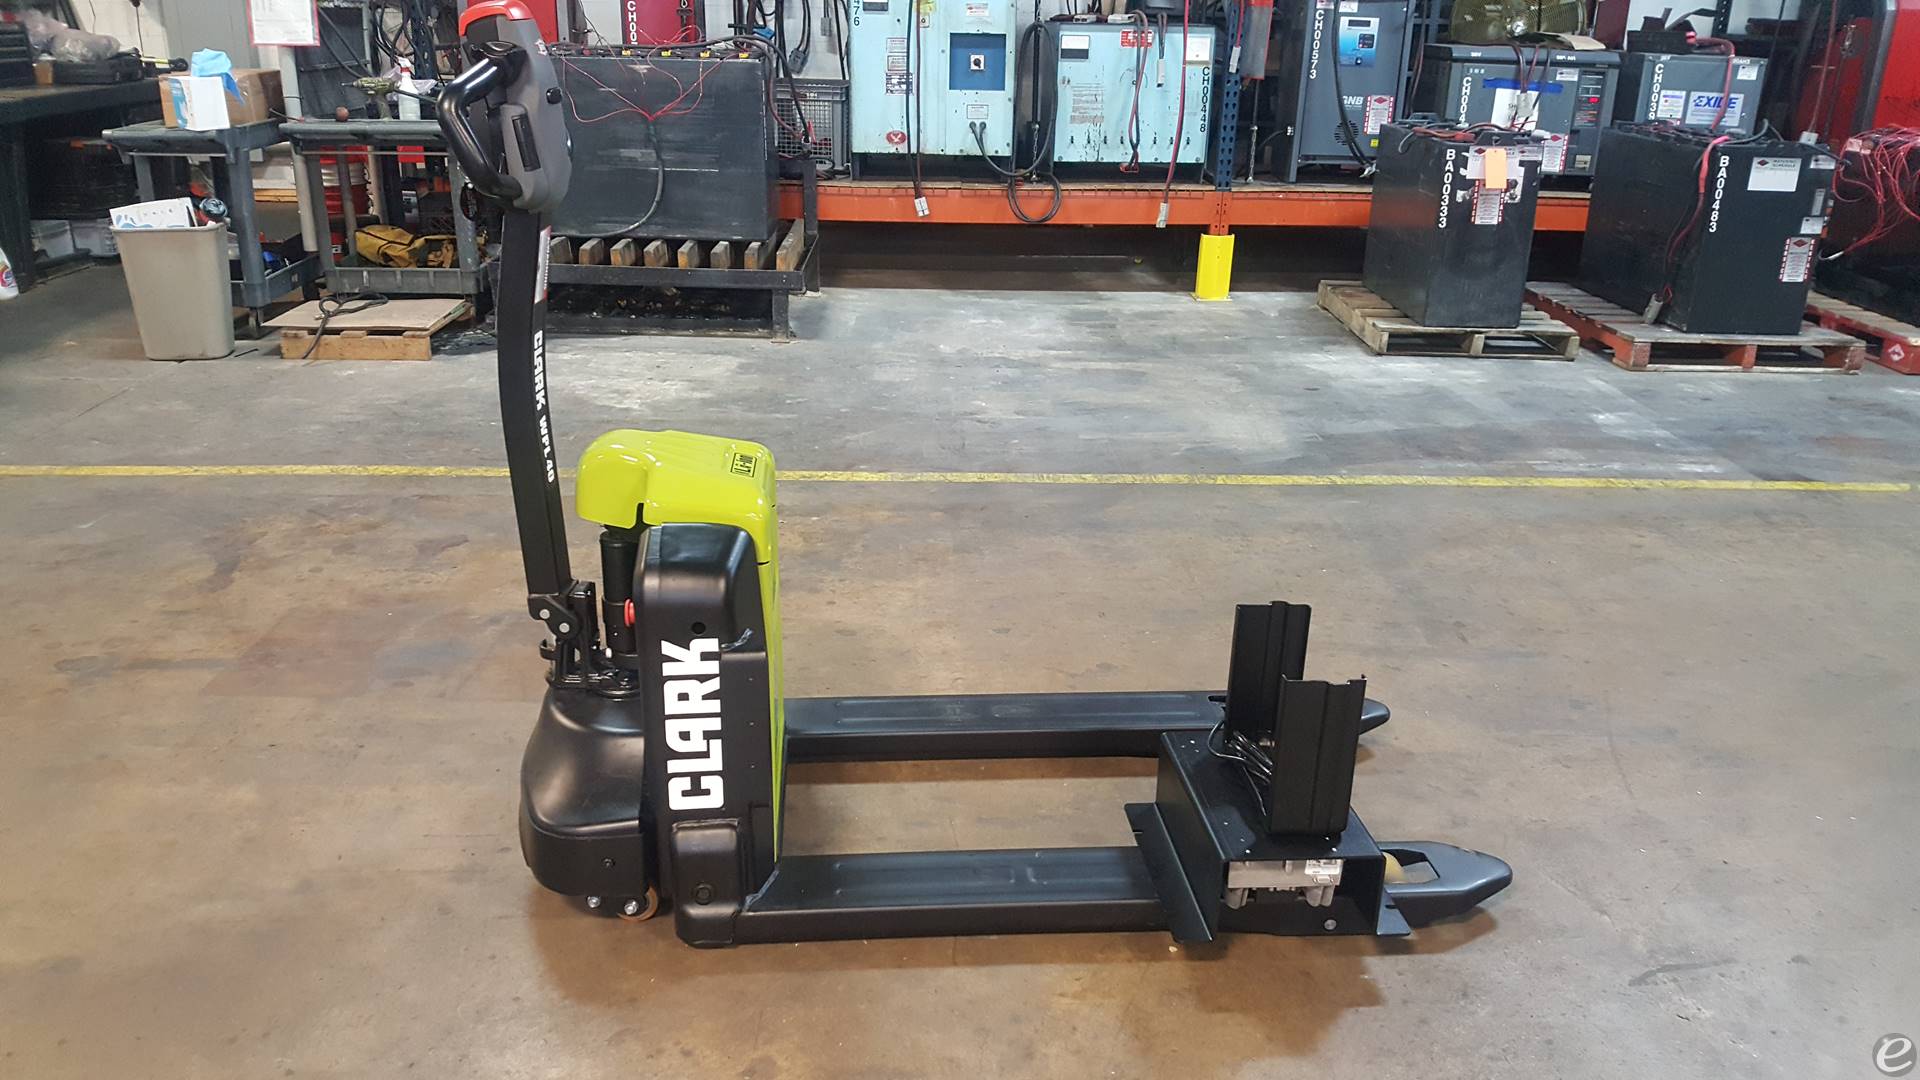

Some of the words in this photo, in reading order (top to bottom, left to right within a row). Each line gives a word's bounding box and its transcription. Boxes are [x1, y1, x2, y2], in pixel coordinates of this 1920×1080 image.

[1309, 9, 1325, 79] CH00573
[1199, 66, 1211, 133] CH00448
[1438, 148, 1456, 228] BA00333
[1708, 155, 1730, 233] BA00483
[533, 330, 547, 411] CLARK
[539, 414, 555, 483] WPL40
[661, 638, 724, 810] CLARK
